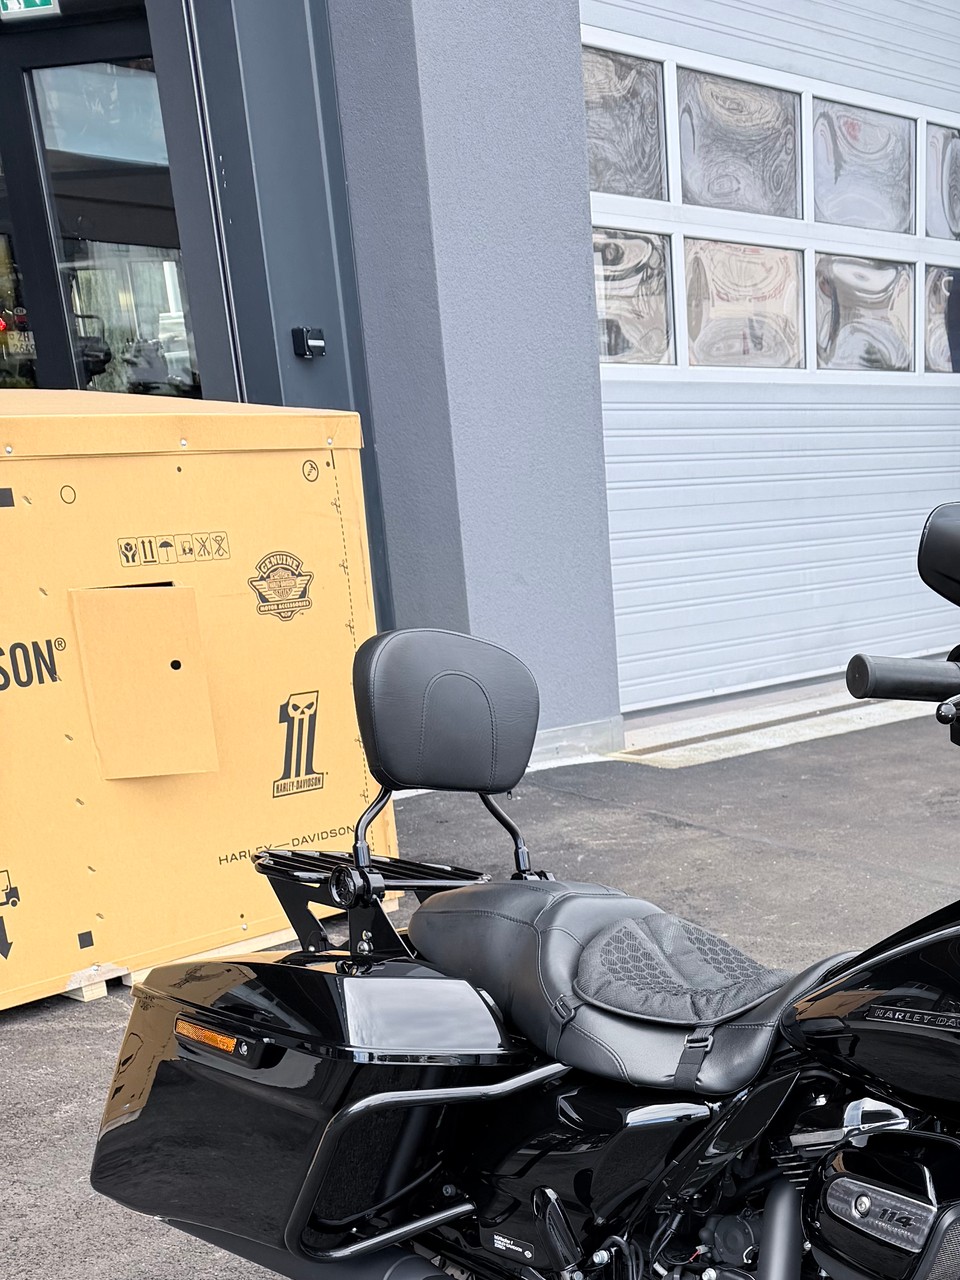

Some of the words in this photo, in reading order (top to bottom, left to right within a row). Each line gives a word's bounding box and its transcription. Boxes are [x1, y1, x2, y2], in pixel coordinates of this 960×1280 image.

[260, 554, 300, 573] GENUINE
[276, 776, 321, 794] HARLEY-DAVIDSON
[879, 1207, 915, 1228] 114
